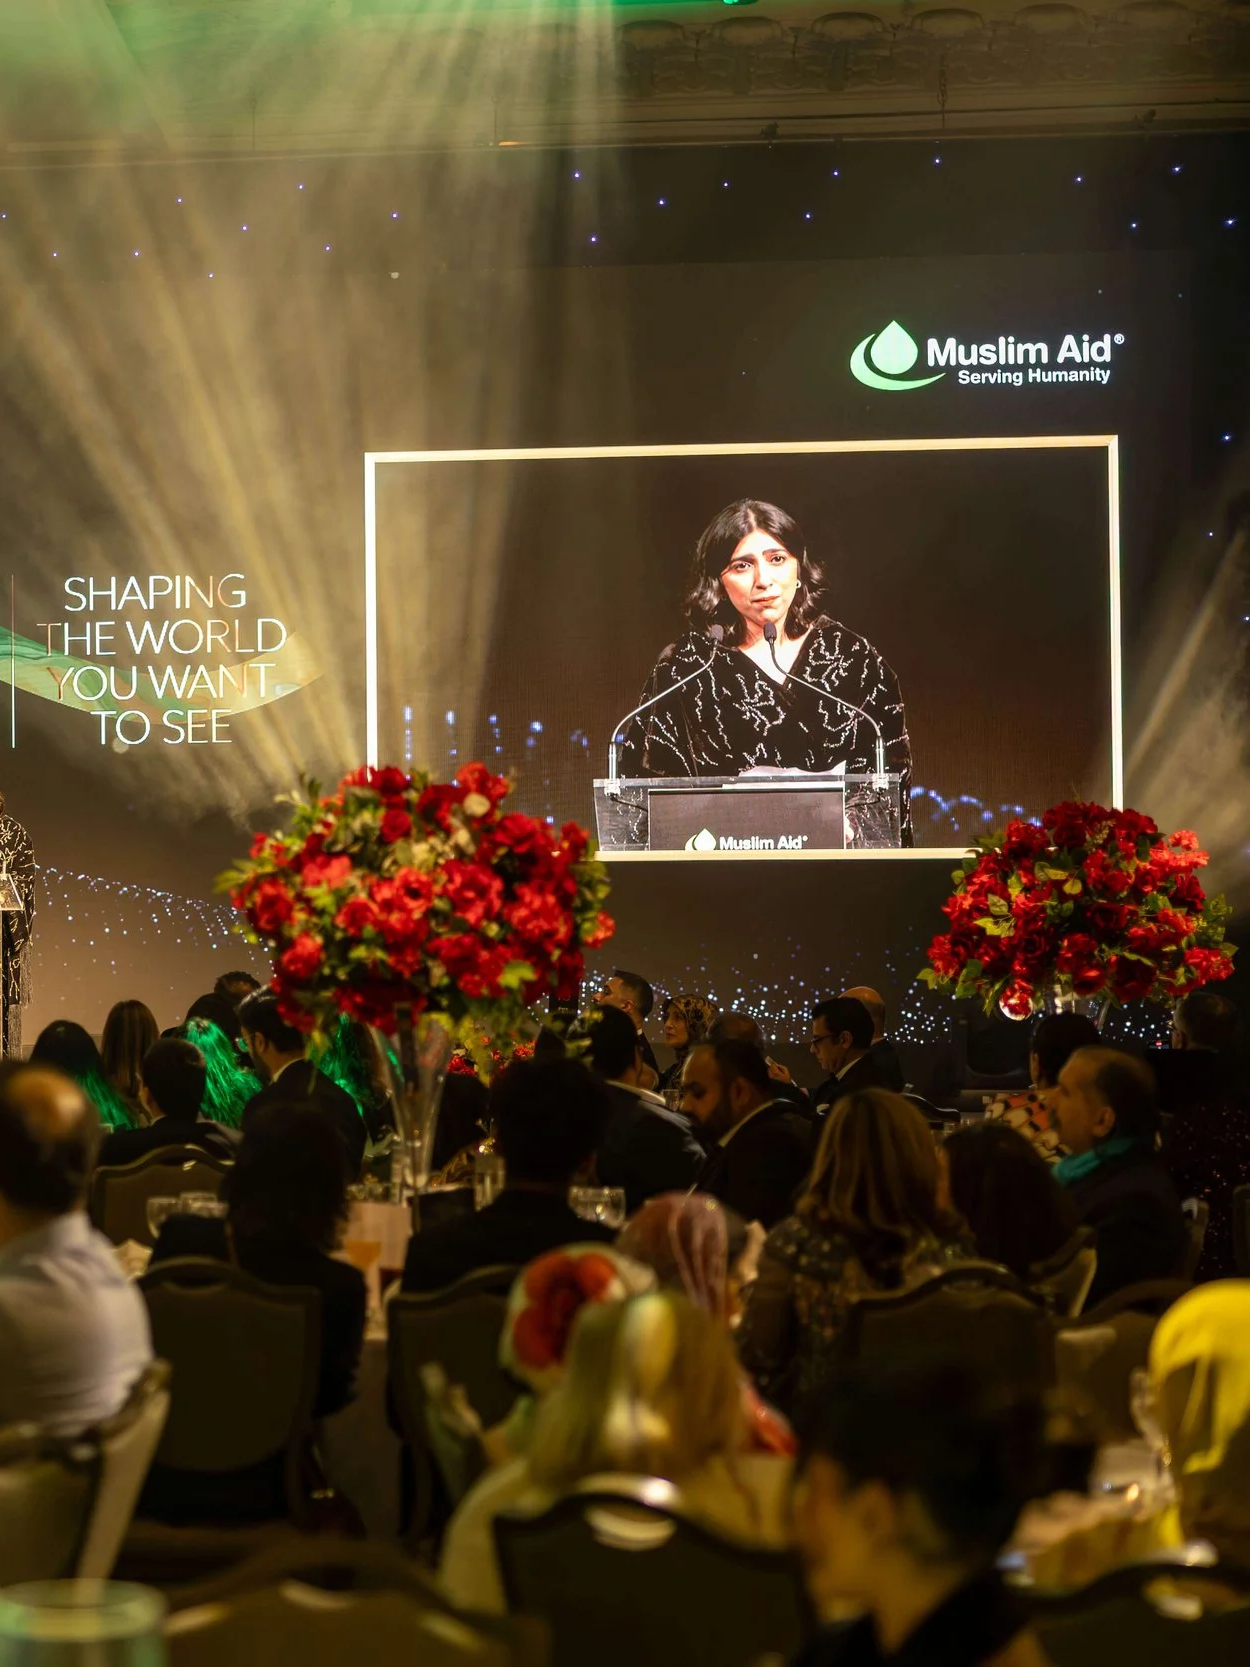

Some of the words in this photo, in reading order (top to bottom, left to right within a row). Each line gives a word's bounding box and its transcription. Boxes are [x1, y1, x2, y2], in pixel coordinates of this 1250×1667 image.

[926, 336, 1049, 367] Muslim
[958, 369, 1023, 386] Serving
[1028, 366, 1111, 384] Humanity
[64, 573, 247, 612] SHAPING
[36, 621, 117, 656] THE
[125, 618, 287, 655] WORLD
[46, 665, 138, 701] YOU
[147, 663, 276, 699] WANT
[90, 709, 151, 745] TO
[162, 709, 232, 744] SEE
[719, 836, 774, 850] Muslim
